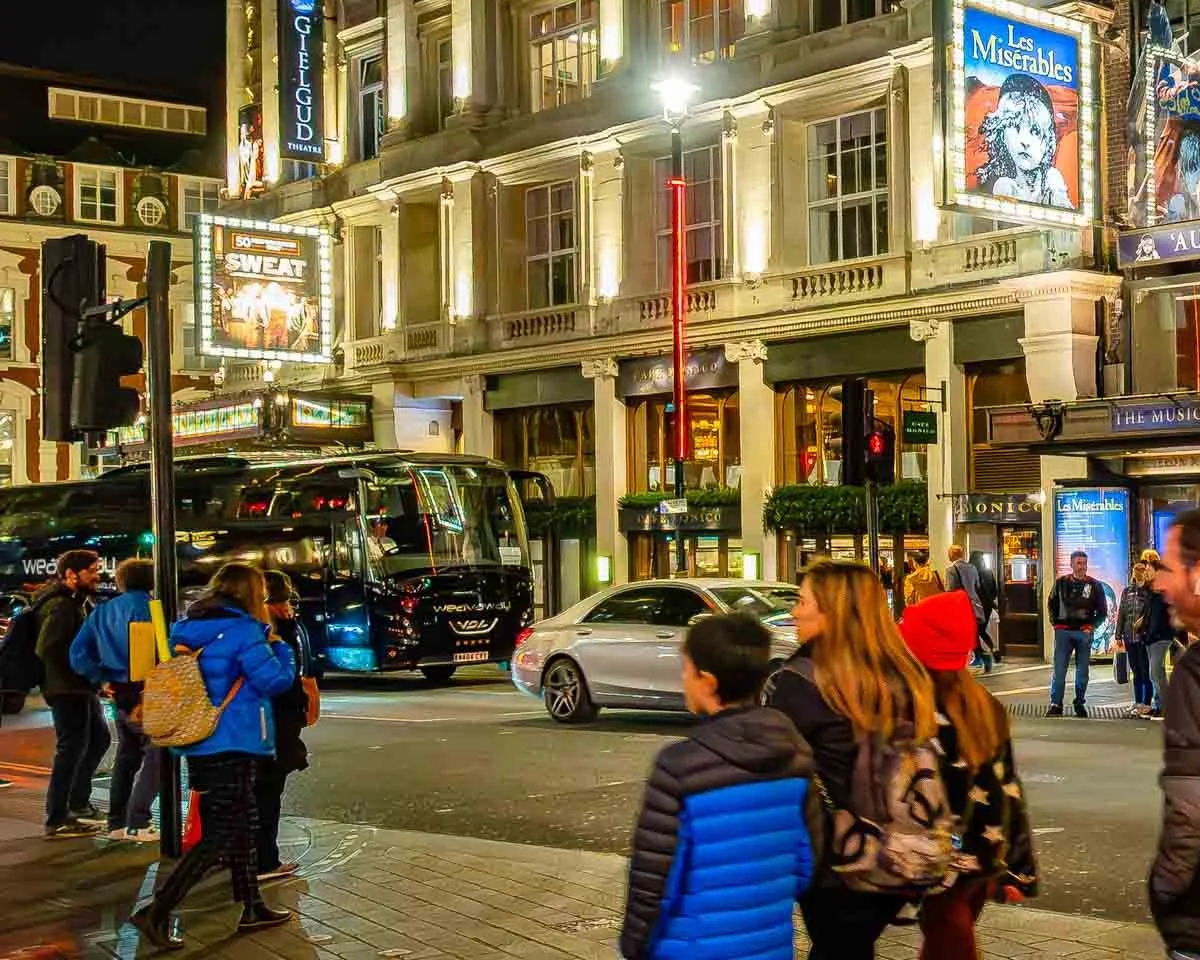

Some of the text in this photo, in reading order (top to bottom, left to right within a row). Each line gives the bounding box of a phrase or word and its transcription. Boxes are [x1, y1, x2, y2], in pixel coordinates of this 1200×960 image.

[1008, 24, 1034, 51] Les
[971, 29, 1073, 83] Misérables
[294, 16, 312, 141] GIELGUD
[288, 142, 322, 153] THEATRE
[225, 253, 307, 278] SWEAT
[1116, 409, 1146, 426] THE
